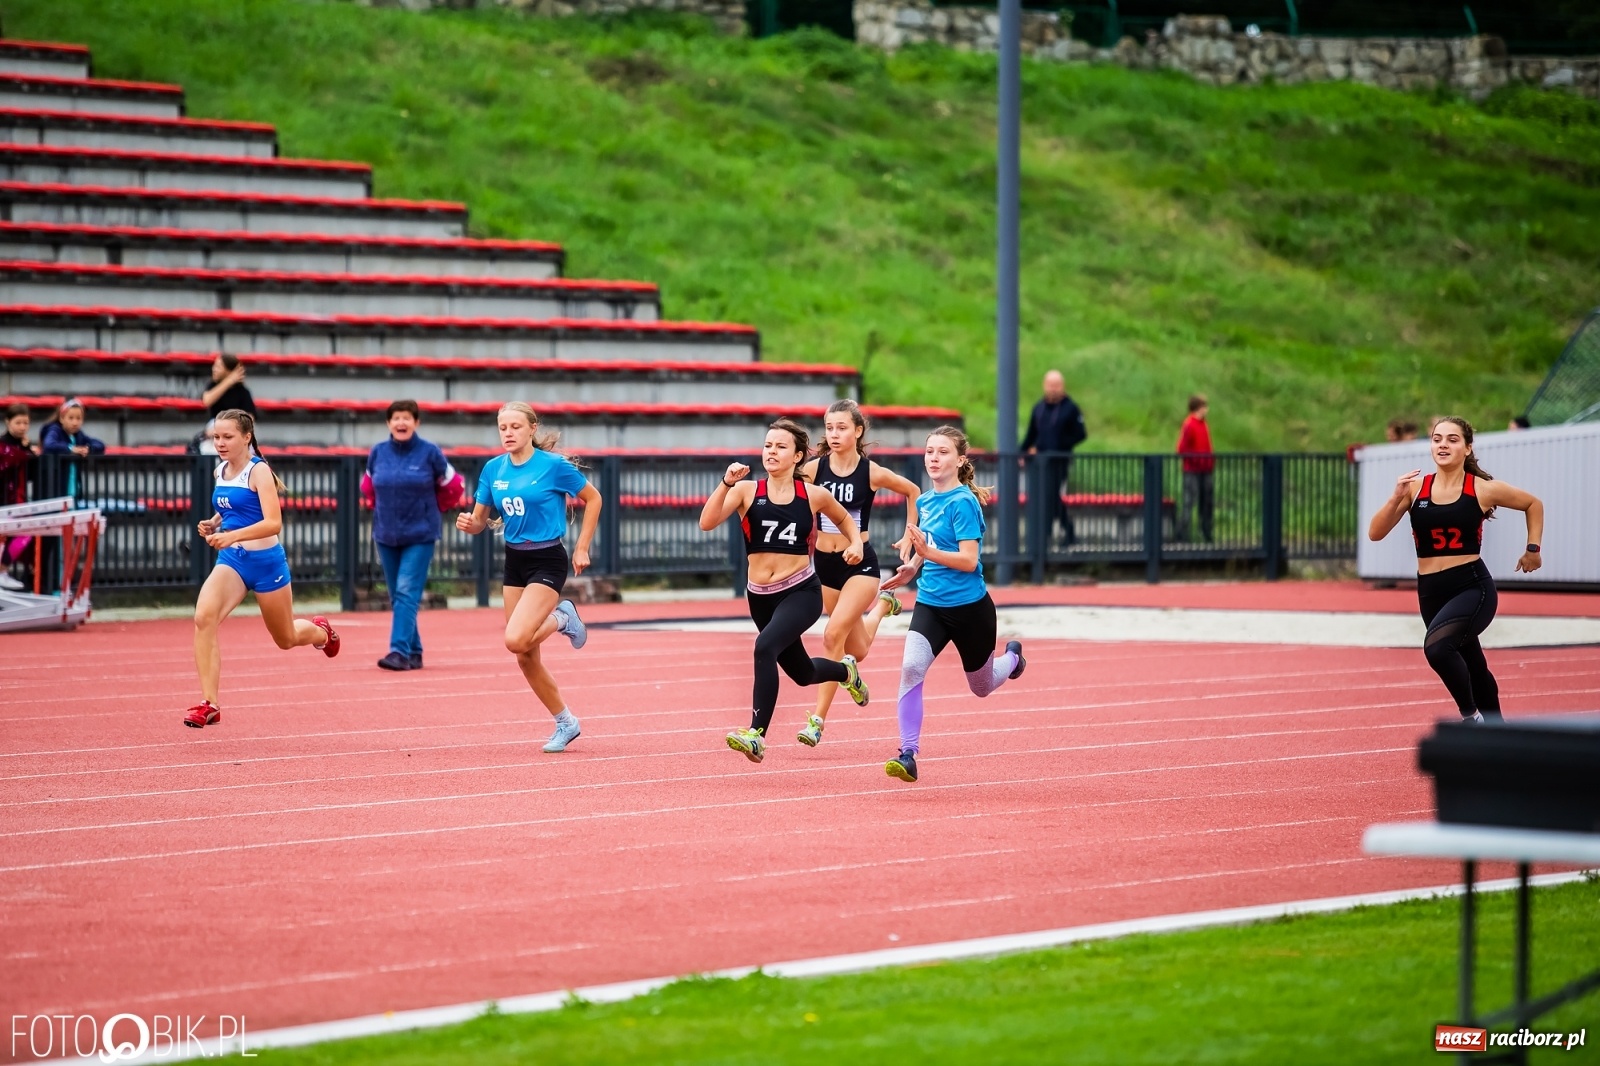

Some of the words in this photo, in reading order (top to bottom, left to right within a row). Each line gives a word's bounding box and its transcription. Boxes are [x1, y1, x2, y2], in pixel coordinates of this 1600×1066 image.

[829, 483, 854, 503] 118
[501, 496, 525, 517] 69
[761, 520, 798, 545] 74
[922, 531, 938, 550] 4
[1431, 528, 1463, 549] 52
